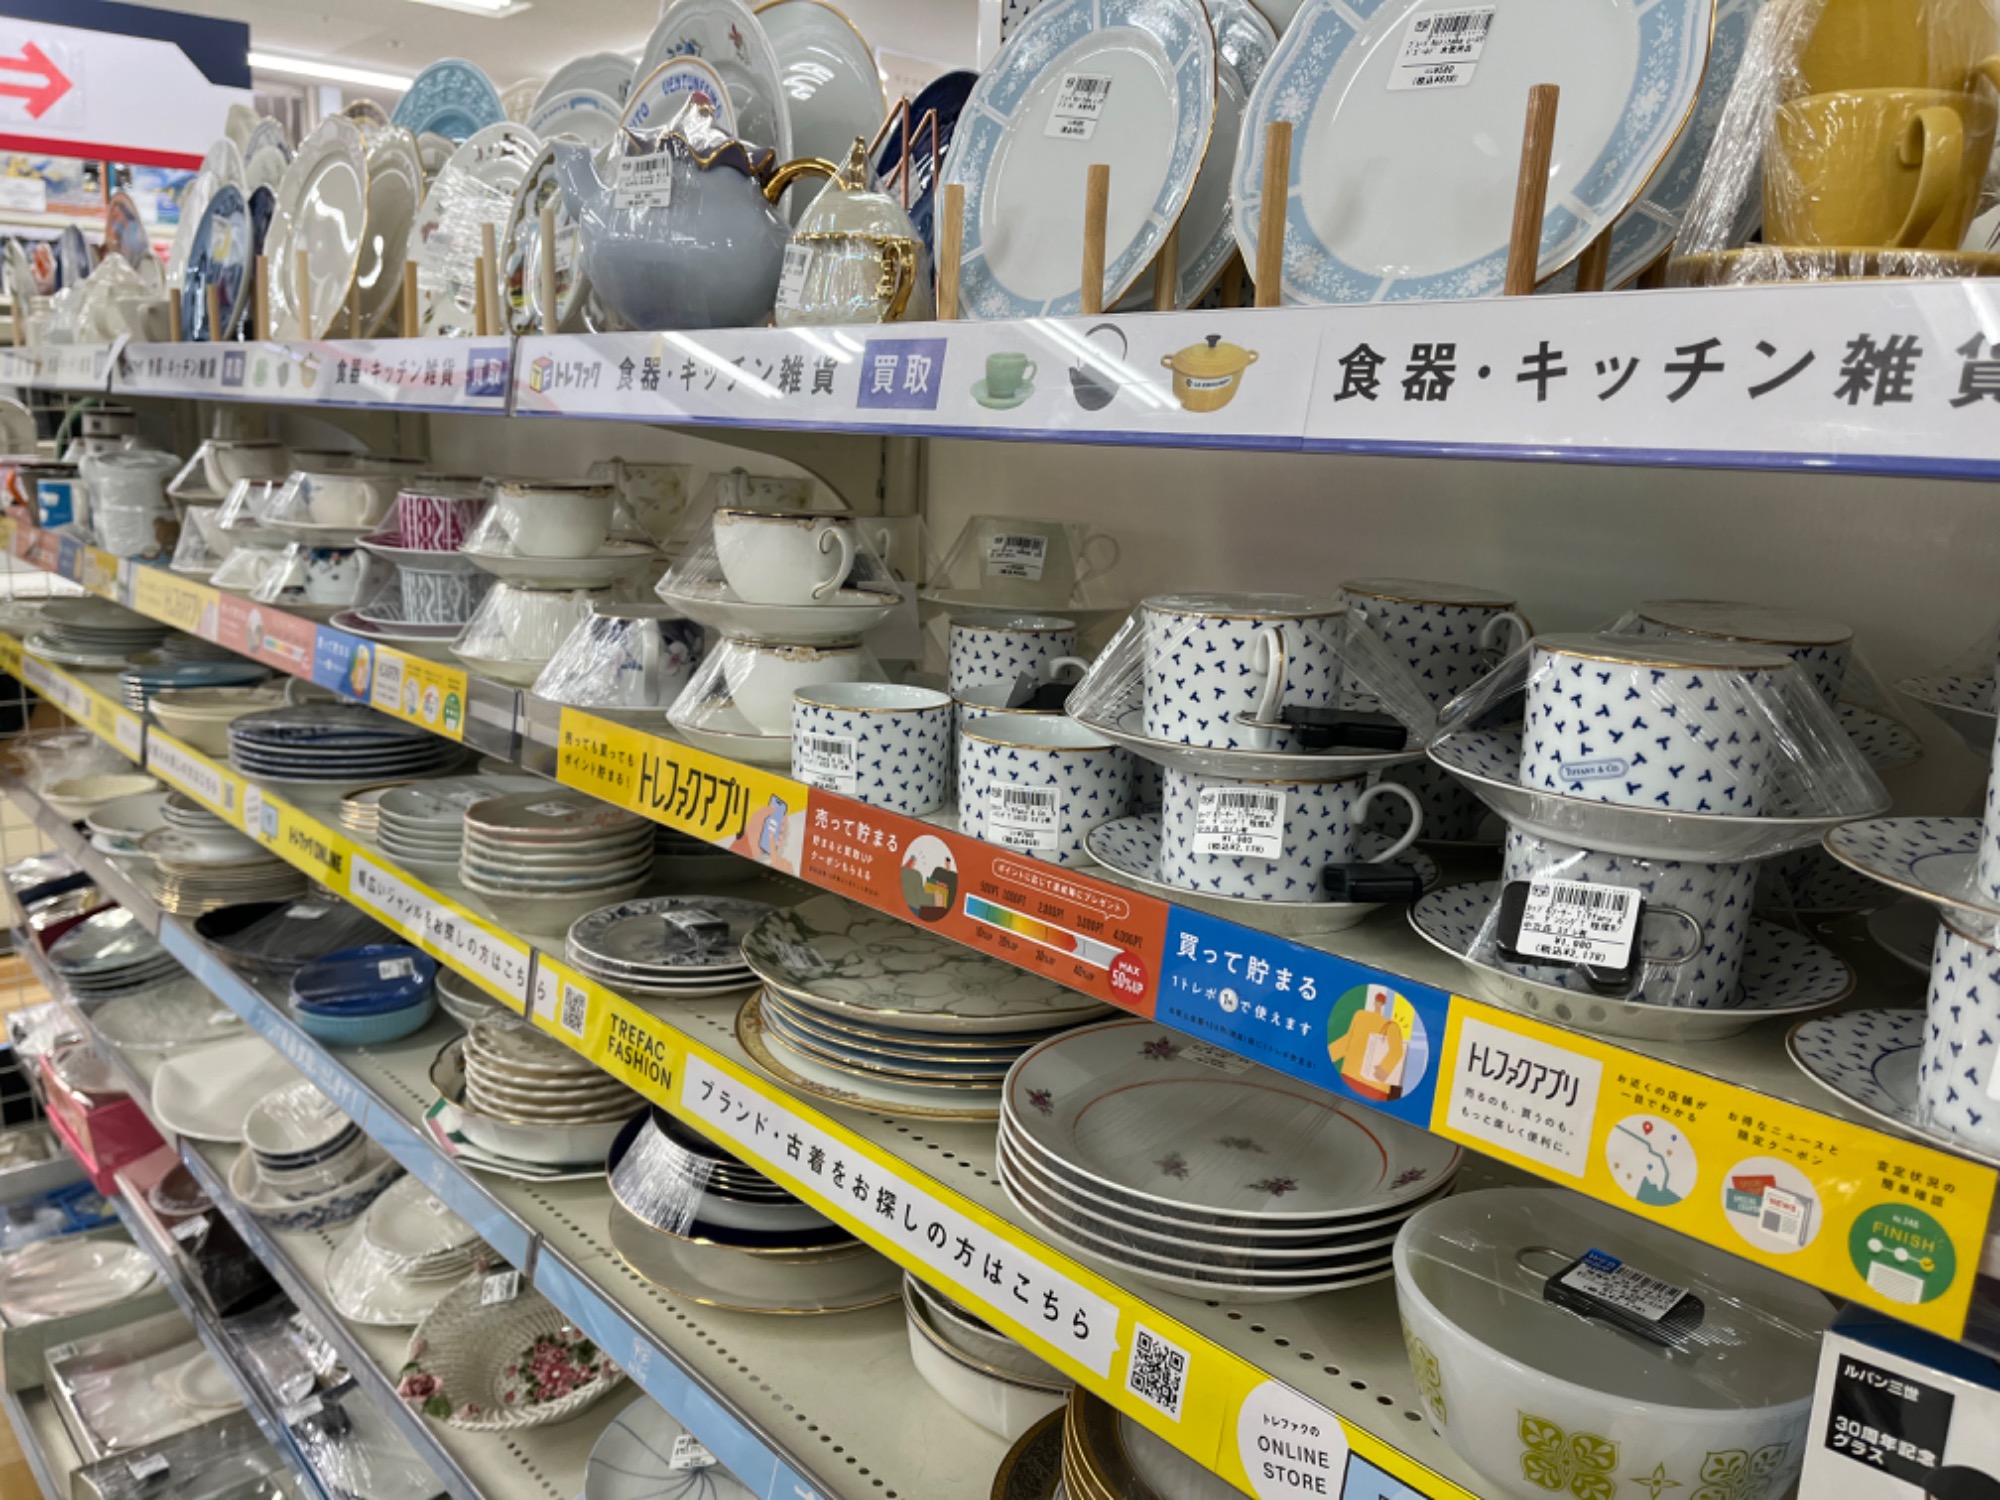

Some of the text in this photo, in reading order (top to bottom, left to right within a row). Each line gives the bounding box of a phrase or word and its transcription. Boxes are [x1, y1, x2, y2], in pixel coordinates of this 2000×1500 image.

[335, 357, 456, 388] 食器・キッチン雑貨
[472, 357, 502, 387] 買取
[555, 361, 601, 389] トレファク
[871, 354, 931, 395] 買取
[1333, 331, 2000, 408] 食器・キッチン雑貨
[638, 751, 751, 841] トレファクアプリ
[814, 808, 898, 853] 売って貯まる
[1118, 961, 1141, 977] MAX
[1176, 931, 1317, 1001] 買って貯まる
[610, 1012, 666, 1062] TREFAC
[607, 1035, 672, 1091] FASHION
[1468, 1041, 1579, 1108] トレファクアプリ
[1616, 1074, 1708, 1111] お近くの店舗が
[1620, 1090, 1697, 1123] 一目でわかる
[1727, 1111, 1839, 1156] お得なニュースと
[1737, 1129, 1823, 1166] 限定クーポン
[1876, 1160, 1956, 1194] 査定状況の
[702, 1079, 1090, 1340] ブランド・古着をお探しの方はこちら
[1768, 1197, 1797, 1214] NEWS
[1871, 1220, 1936, 1253] FINISH
[1844, 1364, 1920, 1403] ルパン三世
[1263, 1413, 1320, 1438] トレファクの
[1834, 1415, 1937, 1468] 30周年記念
[1256, 1434, 1331, 1470] ONLINE
[1832, 1432, 1884, 1466] グラス
[1262, 1461, 1328, 1496] STORE
